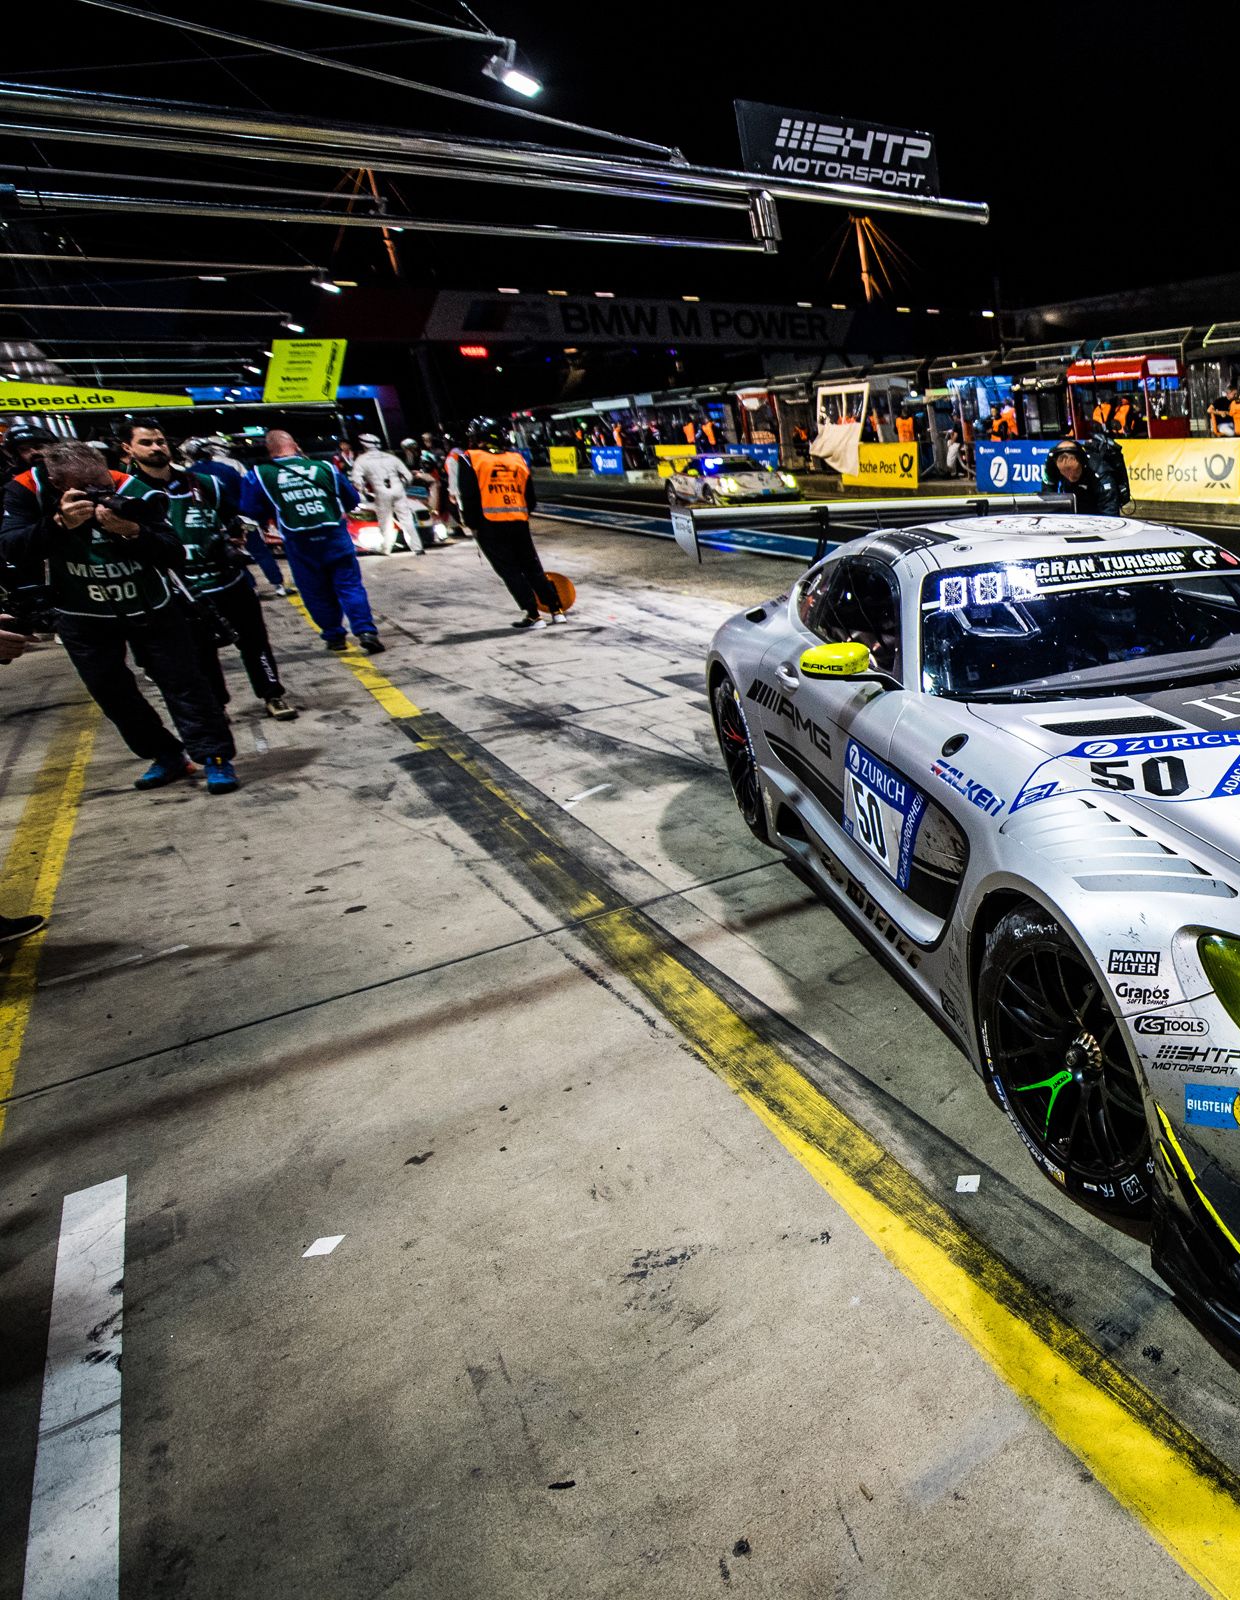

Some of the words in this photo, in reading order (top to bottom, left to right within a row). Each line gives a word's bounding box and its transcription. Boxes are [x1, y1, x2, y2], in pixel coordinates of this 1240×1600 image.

[772, 155, 926, 188] MOTORSPORT
[560, 303, 657, 336] BMW
[668, 306, 700, 337] M
[710, 308, 829, 341] POWER
[858, 461, 877, 474] tsche
[879, 460, 897, 475] Post
[1012, 464, 1046, 482] ZUR
[1129, 464, 1163, 482] tsche
[1167, 464, 1198, 483] Post
[281, 488, 328, 502] MEDIA
[295, 500, 326, 516] 966
[66, 561, 143, 578] MEDIA
[1035, 558, 1097, 577] GRAN
[1100, 551, 1184, 571] TURISMO
[1037, 576, 1061, 584] THE
[1067, 574, 1091, 582] REAL
[1091, 569, 1134, 579] DRIVING
[1136, 565, 1186, 575] SIMULATOR
[806, 663, 844, 672] AMG
[768, 691, 832, 761] AMG
[862, 757, 906, 806] ZURICH
[1090, 756, 1190, 797] 50
[930, 759, 1006, 817] FALKEN
[852, 777, 888, 860] 50
[1112, 951, 1158, 963] MANN
[1110, 962, 1156, 974] FILTER
[1138, 1018, 1165, 1032] KS
[1164, 1020, 1205, 1033] TOOLS
[1151, 1061, 1238, 1075] MOTORSPORT
[1052, 1073, 1070, 1089] FRONT
[1186, 1098, 1233, 1114] BILSTEIN
